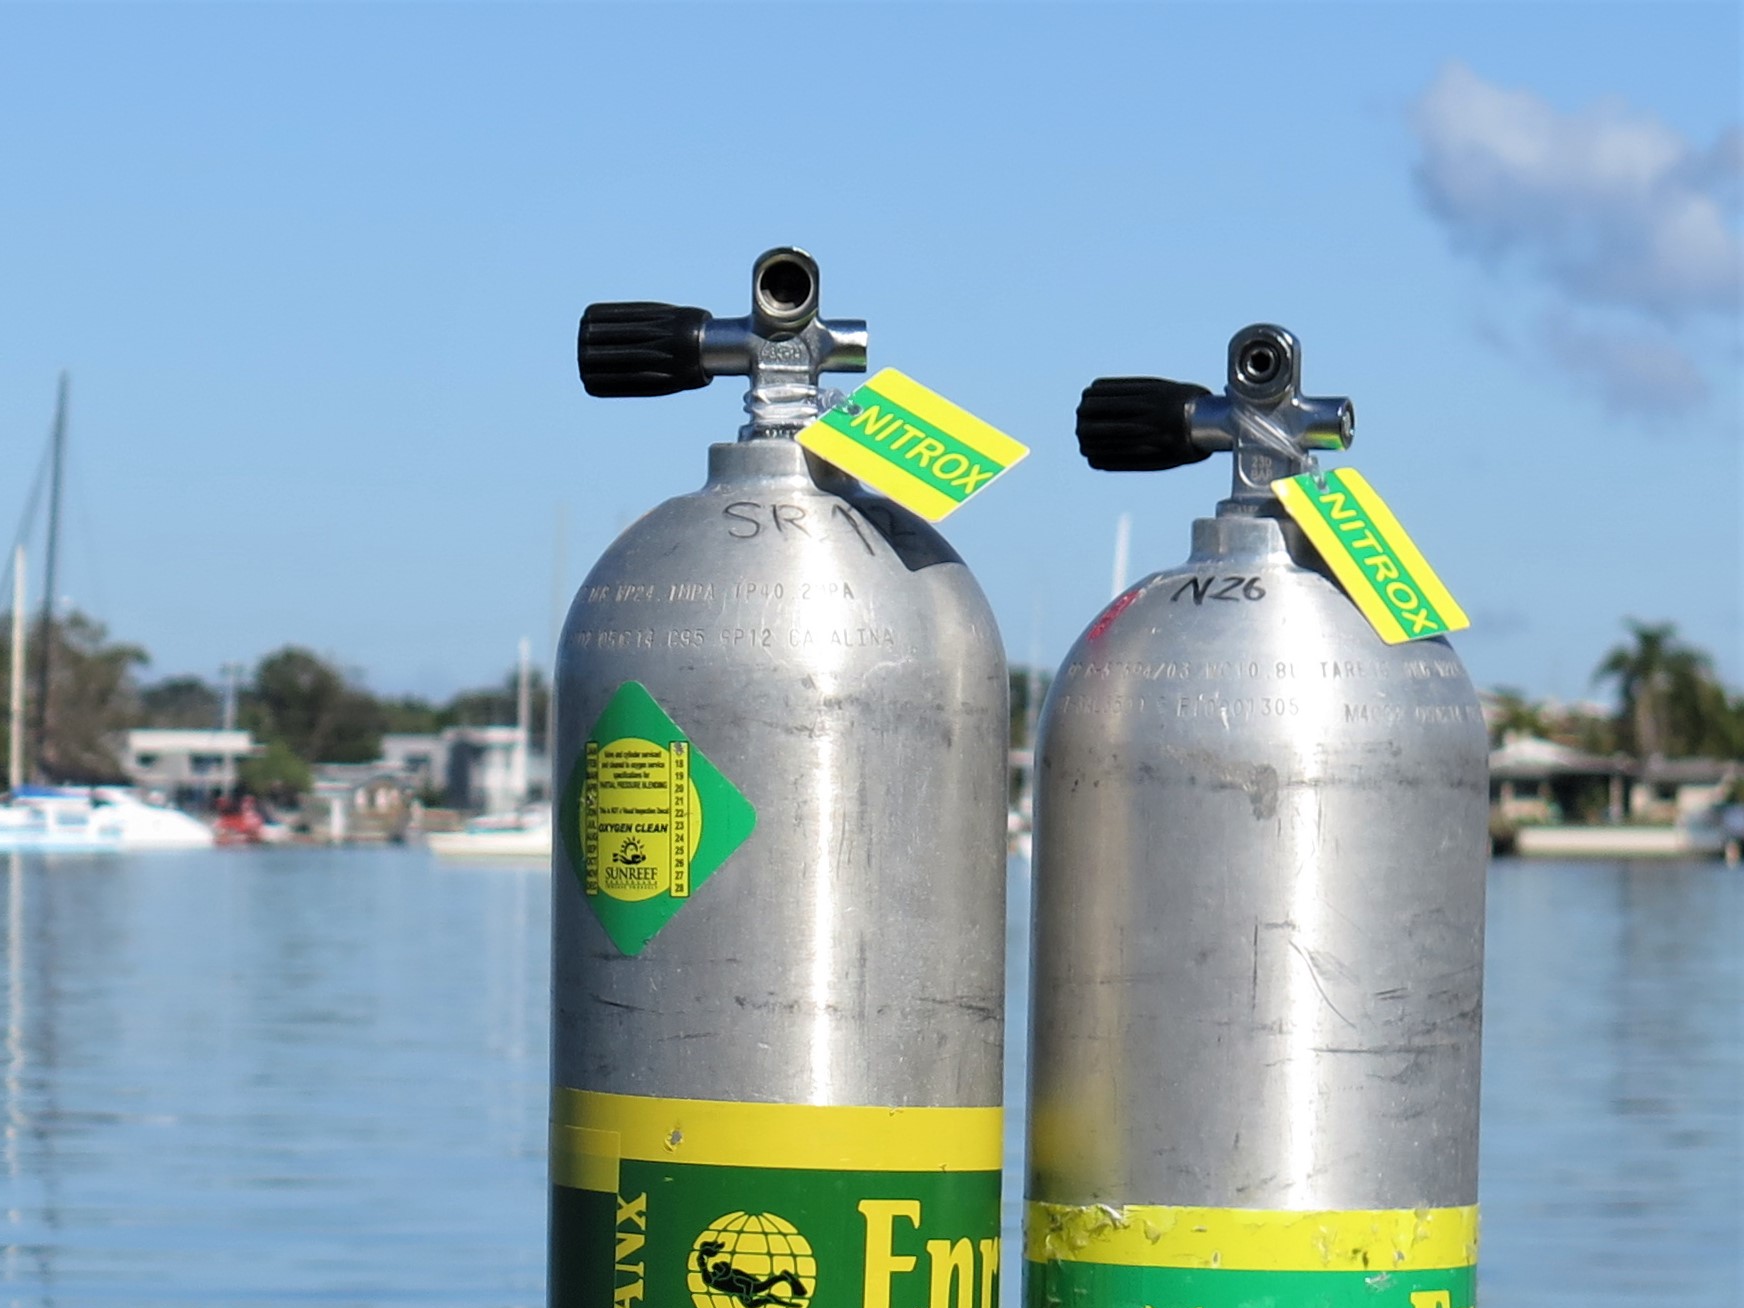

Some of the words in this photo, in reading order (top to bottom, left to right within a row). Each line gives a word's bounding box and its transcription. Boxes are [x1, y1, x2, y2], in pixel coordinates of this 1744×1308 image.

[850, 404, 994, 495] NITROX
[1319, 492, 1439, 634] NITROX
[599, 823, 633, 833] OXYGEN
[635, 823, 668, 834] CLEAN
[605, 866, 658, 880] SUNREEF
